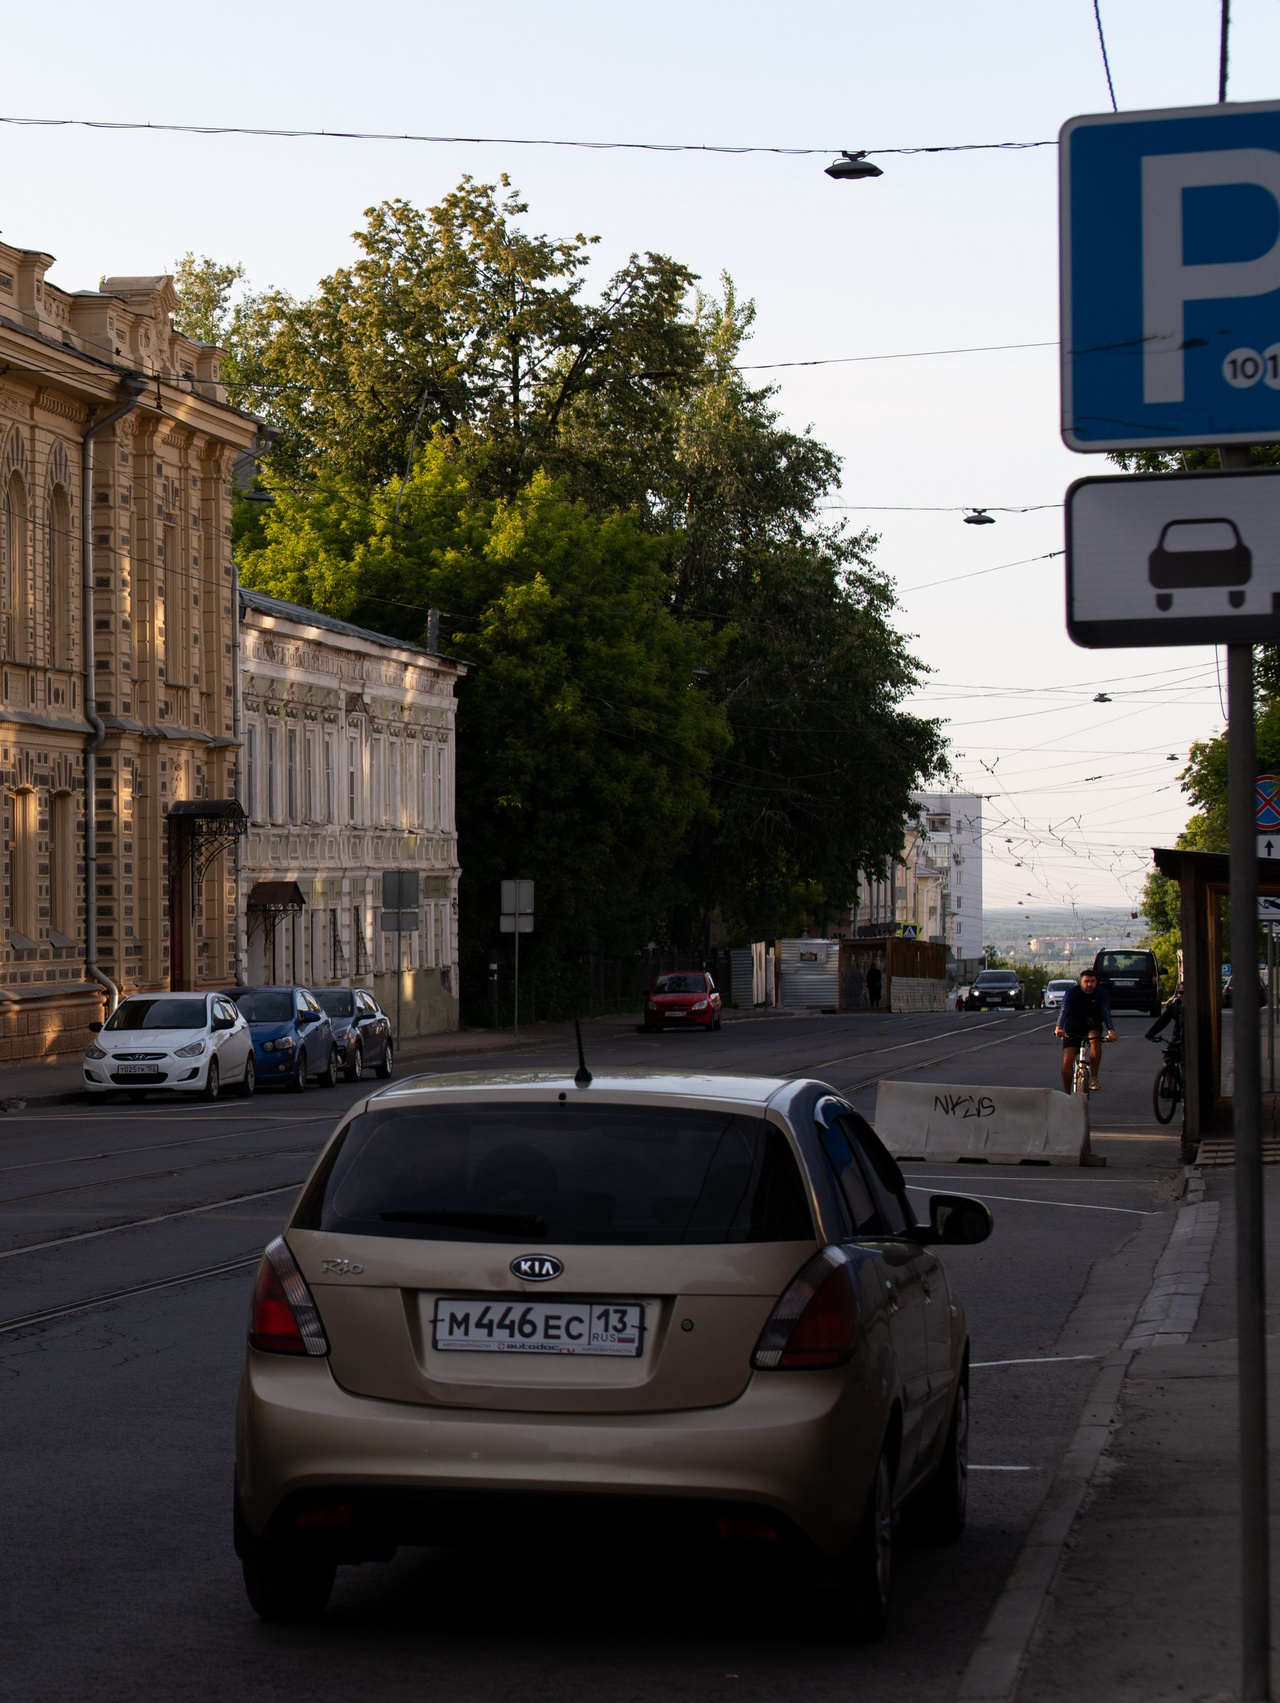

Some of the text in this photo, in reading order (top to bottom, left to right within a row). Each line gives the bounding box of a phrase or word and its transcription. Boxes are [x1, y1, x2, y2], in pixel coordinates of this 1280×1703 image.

[1141, 148, 1280, 404] P
[1227, 353, 1280, 380] 10 1
[322, 1258, 364, 1275] Rio
[520, 1259, 554, 1275] KIA
[448, 1306, 628, 1340] М446ЕС 13
[592, 1332, 616, 1343] RUS
